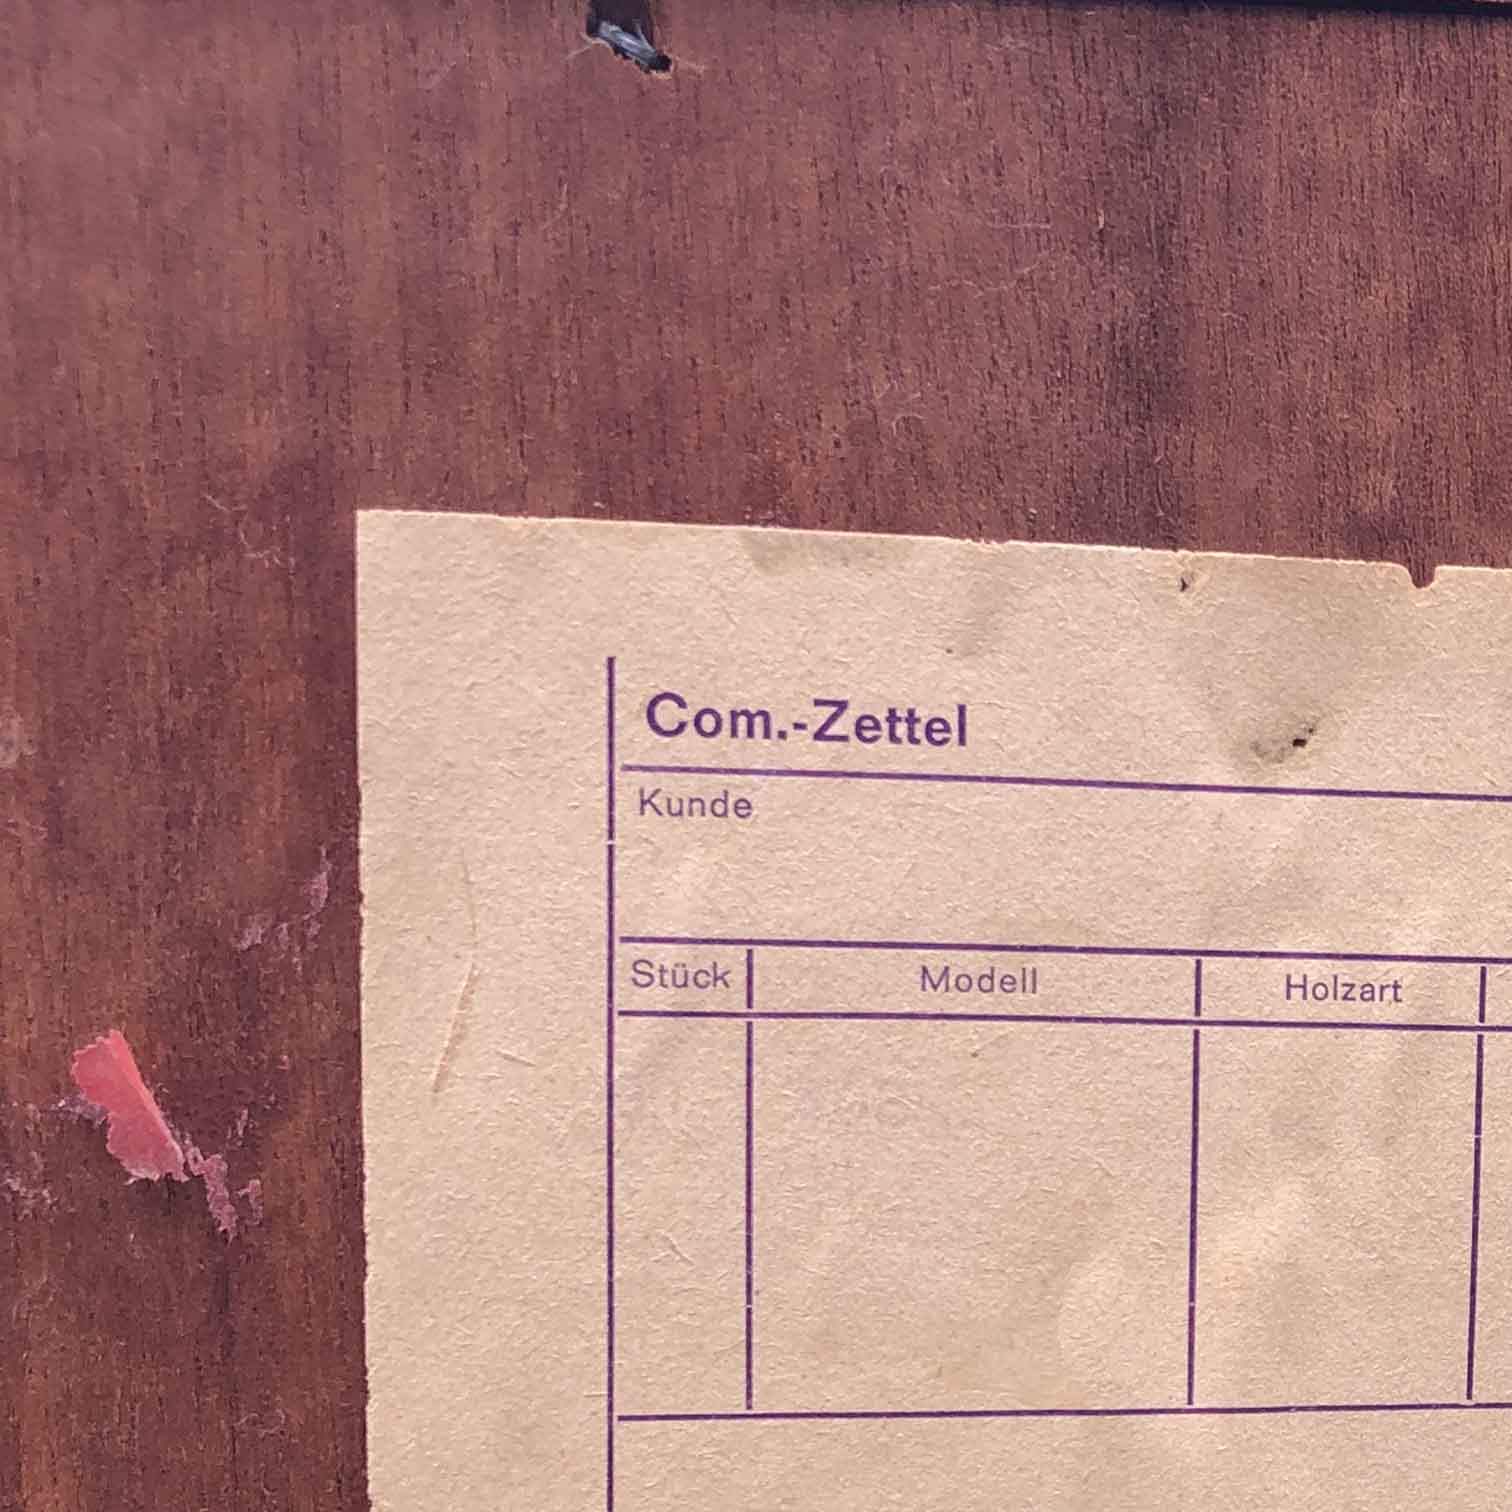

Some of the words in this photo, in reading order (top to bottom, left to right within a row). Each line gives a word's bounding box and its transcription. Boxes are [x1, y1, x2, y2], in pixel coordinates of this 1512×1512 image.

[645, 691, 967, 747] Com.-Zettel
[637, 787, 754, 820] Kunde
[630, 959, 731, 990] Stück
[919, 964, 1038, 995] Modell
[1284, 973, 1404, 1004] Holzart
